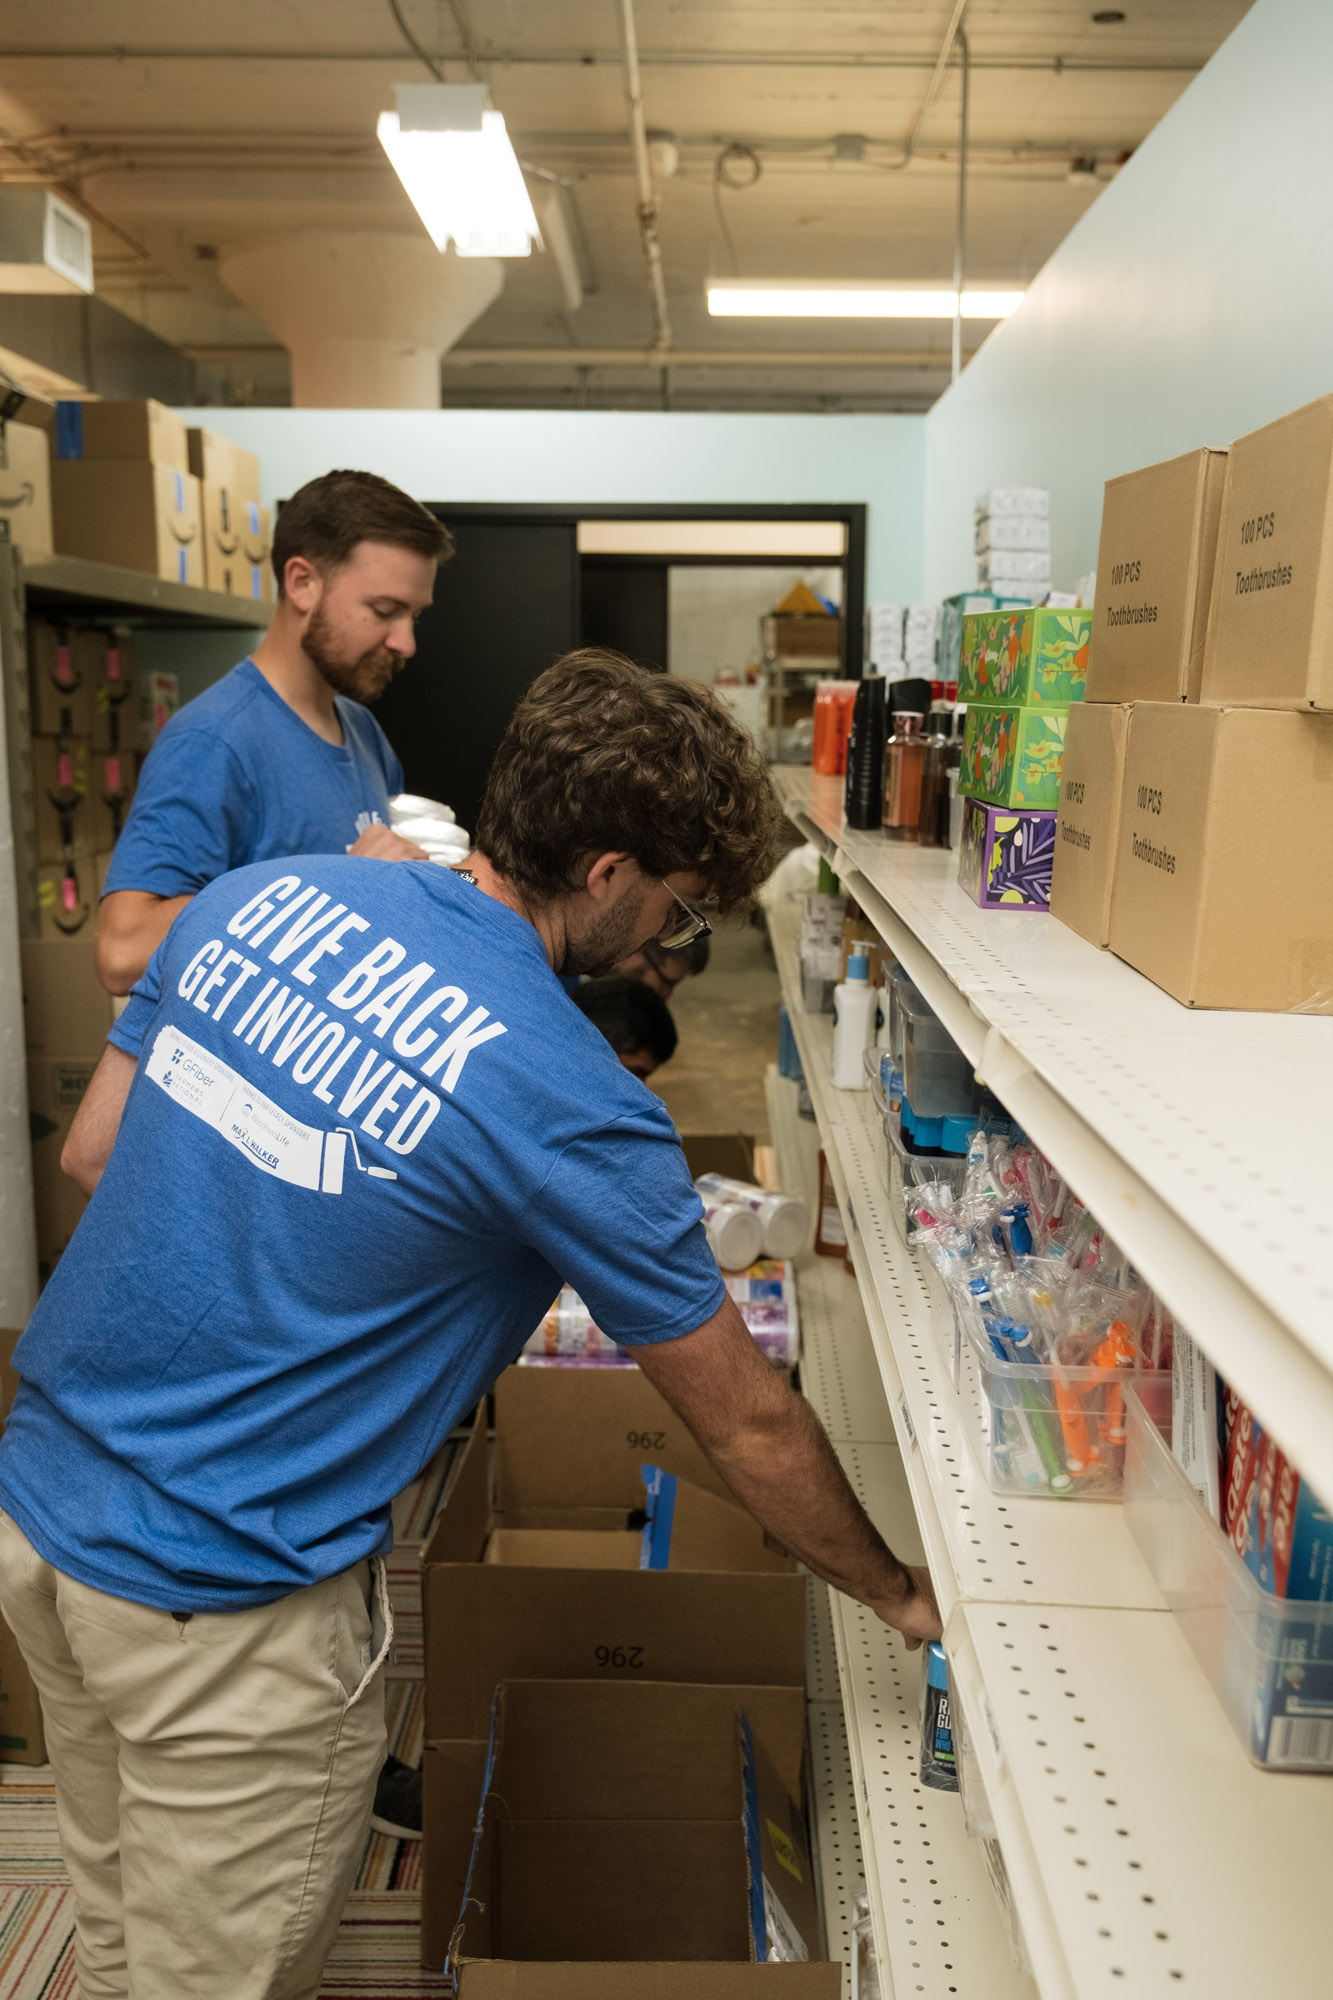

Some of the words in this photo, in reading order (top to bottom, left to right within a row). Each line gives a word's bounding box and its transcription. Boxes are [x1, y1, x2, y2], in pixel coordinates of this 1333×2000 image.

[1240, 520, 1255, 545] 100
[1255, 512, 1275, 542] PCS
[1111, 564, 1124, 586] 100
[1124, 560, 1141, 584] PCS
[1235, 561, 1292, 595] Toothbrushes
[1107, 602, 1158, 627] Toothbrushes
[1065, 781, 1074, 801] 100
[1074, 783, 1085, 806] PCS
[1137, 784, 1148, 811] 100
[1148, 789, 1162, 816] PCS
[1061, 821, 1091, 852] Toothbrushes
[1132, 832, 1175, 875] Toothbrushes
[227, 875, 371, 985] GIVE
[327, 937, 508, 1093] BACK
[178, 940, 261, 1022] GET
[232, 977, 441, 1155] INVOLVED
[182, 1059, 215, 1087] GFiber
[231, 1124, 248, 1141] MAX
[250, 1141, 279, 1168] WALKER
[626, 1431, 666, 1450] 296
[1226, 1408, 1250, 1522] gate
[595, 1645, 644, 1668] 296
